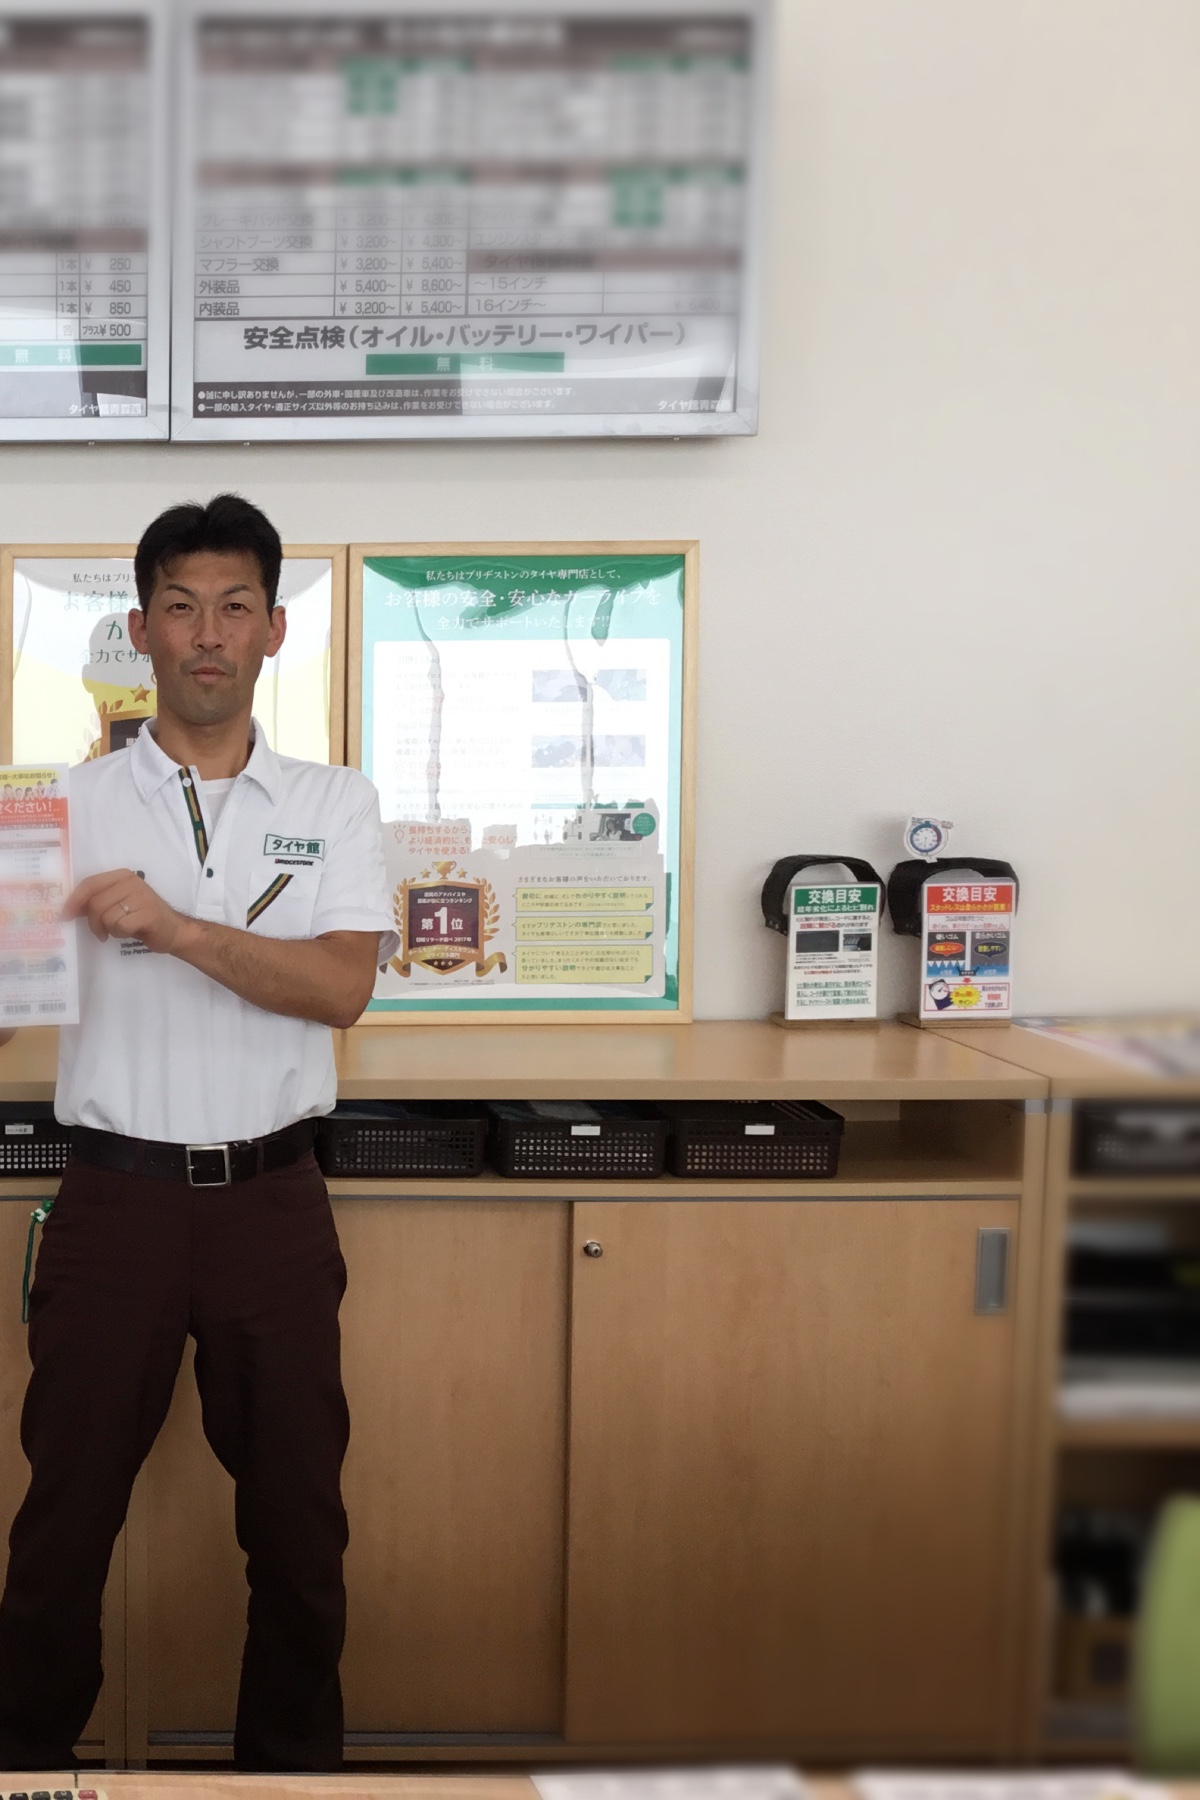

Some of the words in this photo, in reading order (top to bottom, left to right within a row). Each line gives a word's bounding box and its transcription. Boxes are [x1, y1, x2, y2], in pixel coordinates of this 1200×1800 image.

[109, 258, 131, 271] 250
[201, 257, 279, 272] マフラー交換
[109, 279, 131, 293] 450
[199, 279, 240, 295] 外装品
[109, 302, 131, 315] 850
[199, 302, 240, 317] 内装品
[109, 323, 131, 337] 500
[272, 839, 320, 854] タイヤ館
[808, 888, 862, 904] 交換目安
[942, 887, 997, 903] 交換目安
